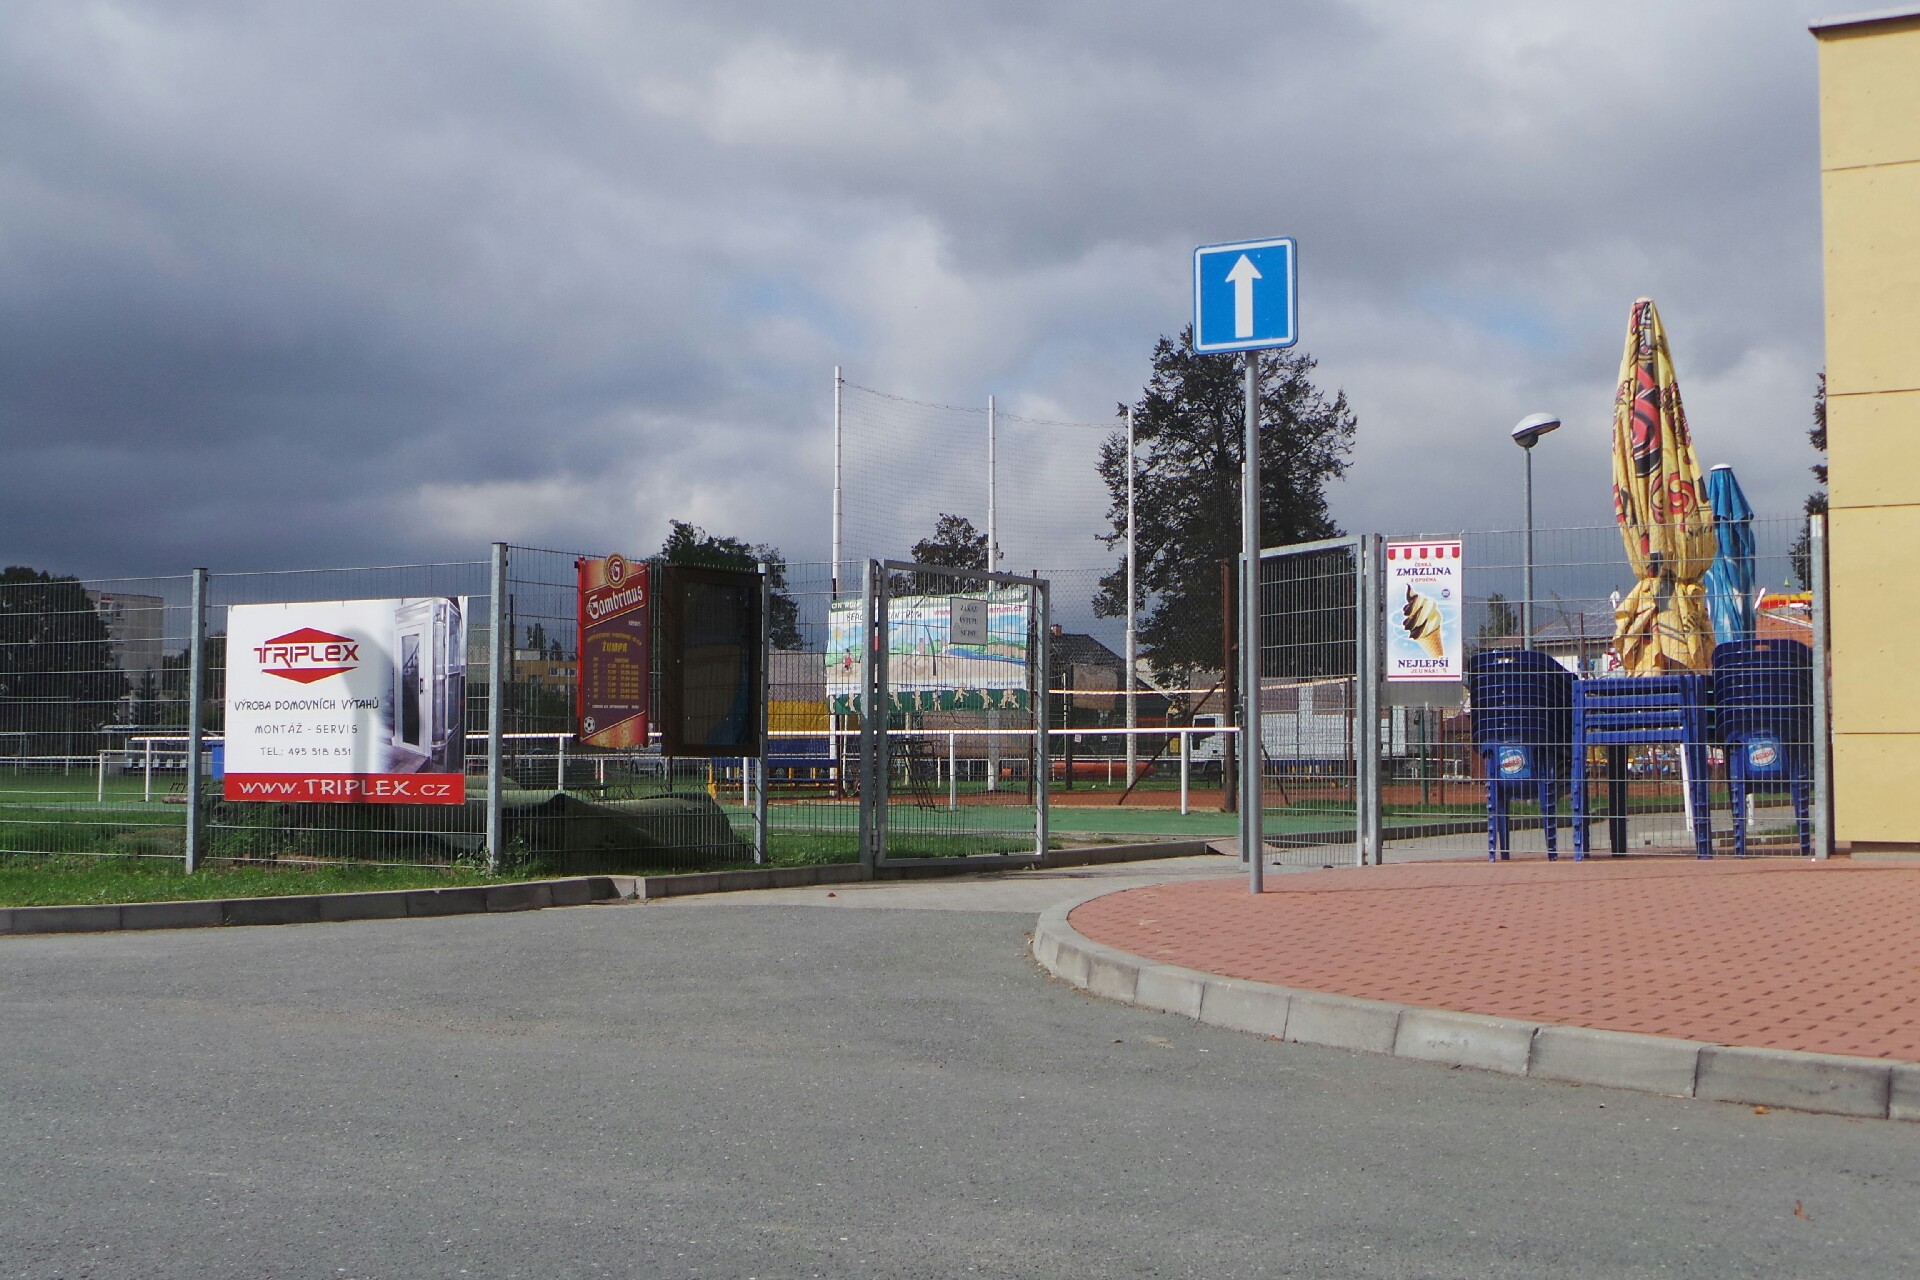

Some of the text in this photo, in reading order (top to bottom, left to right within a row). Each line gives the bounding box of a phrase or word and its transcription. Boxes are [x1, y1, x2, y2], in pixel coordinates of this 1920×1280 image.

[1396, 567, 1452, 576] ZMRZLINA
[586, 585, 643, 619] Gambrinus
[1398, 657, 1449, 668] NEJLEPŠÍ
[234, 697, 379, 711] VÝROBA DOMOVNÍCH VÝTAHŮ
[254, 722, 303, 734] MONTÁŽ
[316, 724, 358, 734] SERVIS
[288, 747, 306, 756] 495
[311, 747, 329, 756] 518
[333, 747, 351, 756] 851
